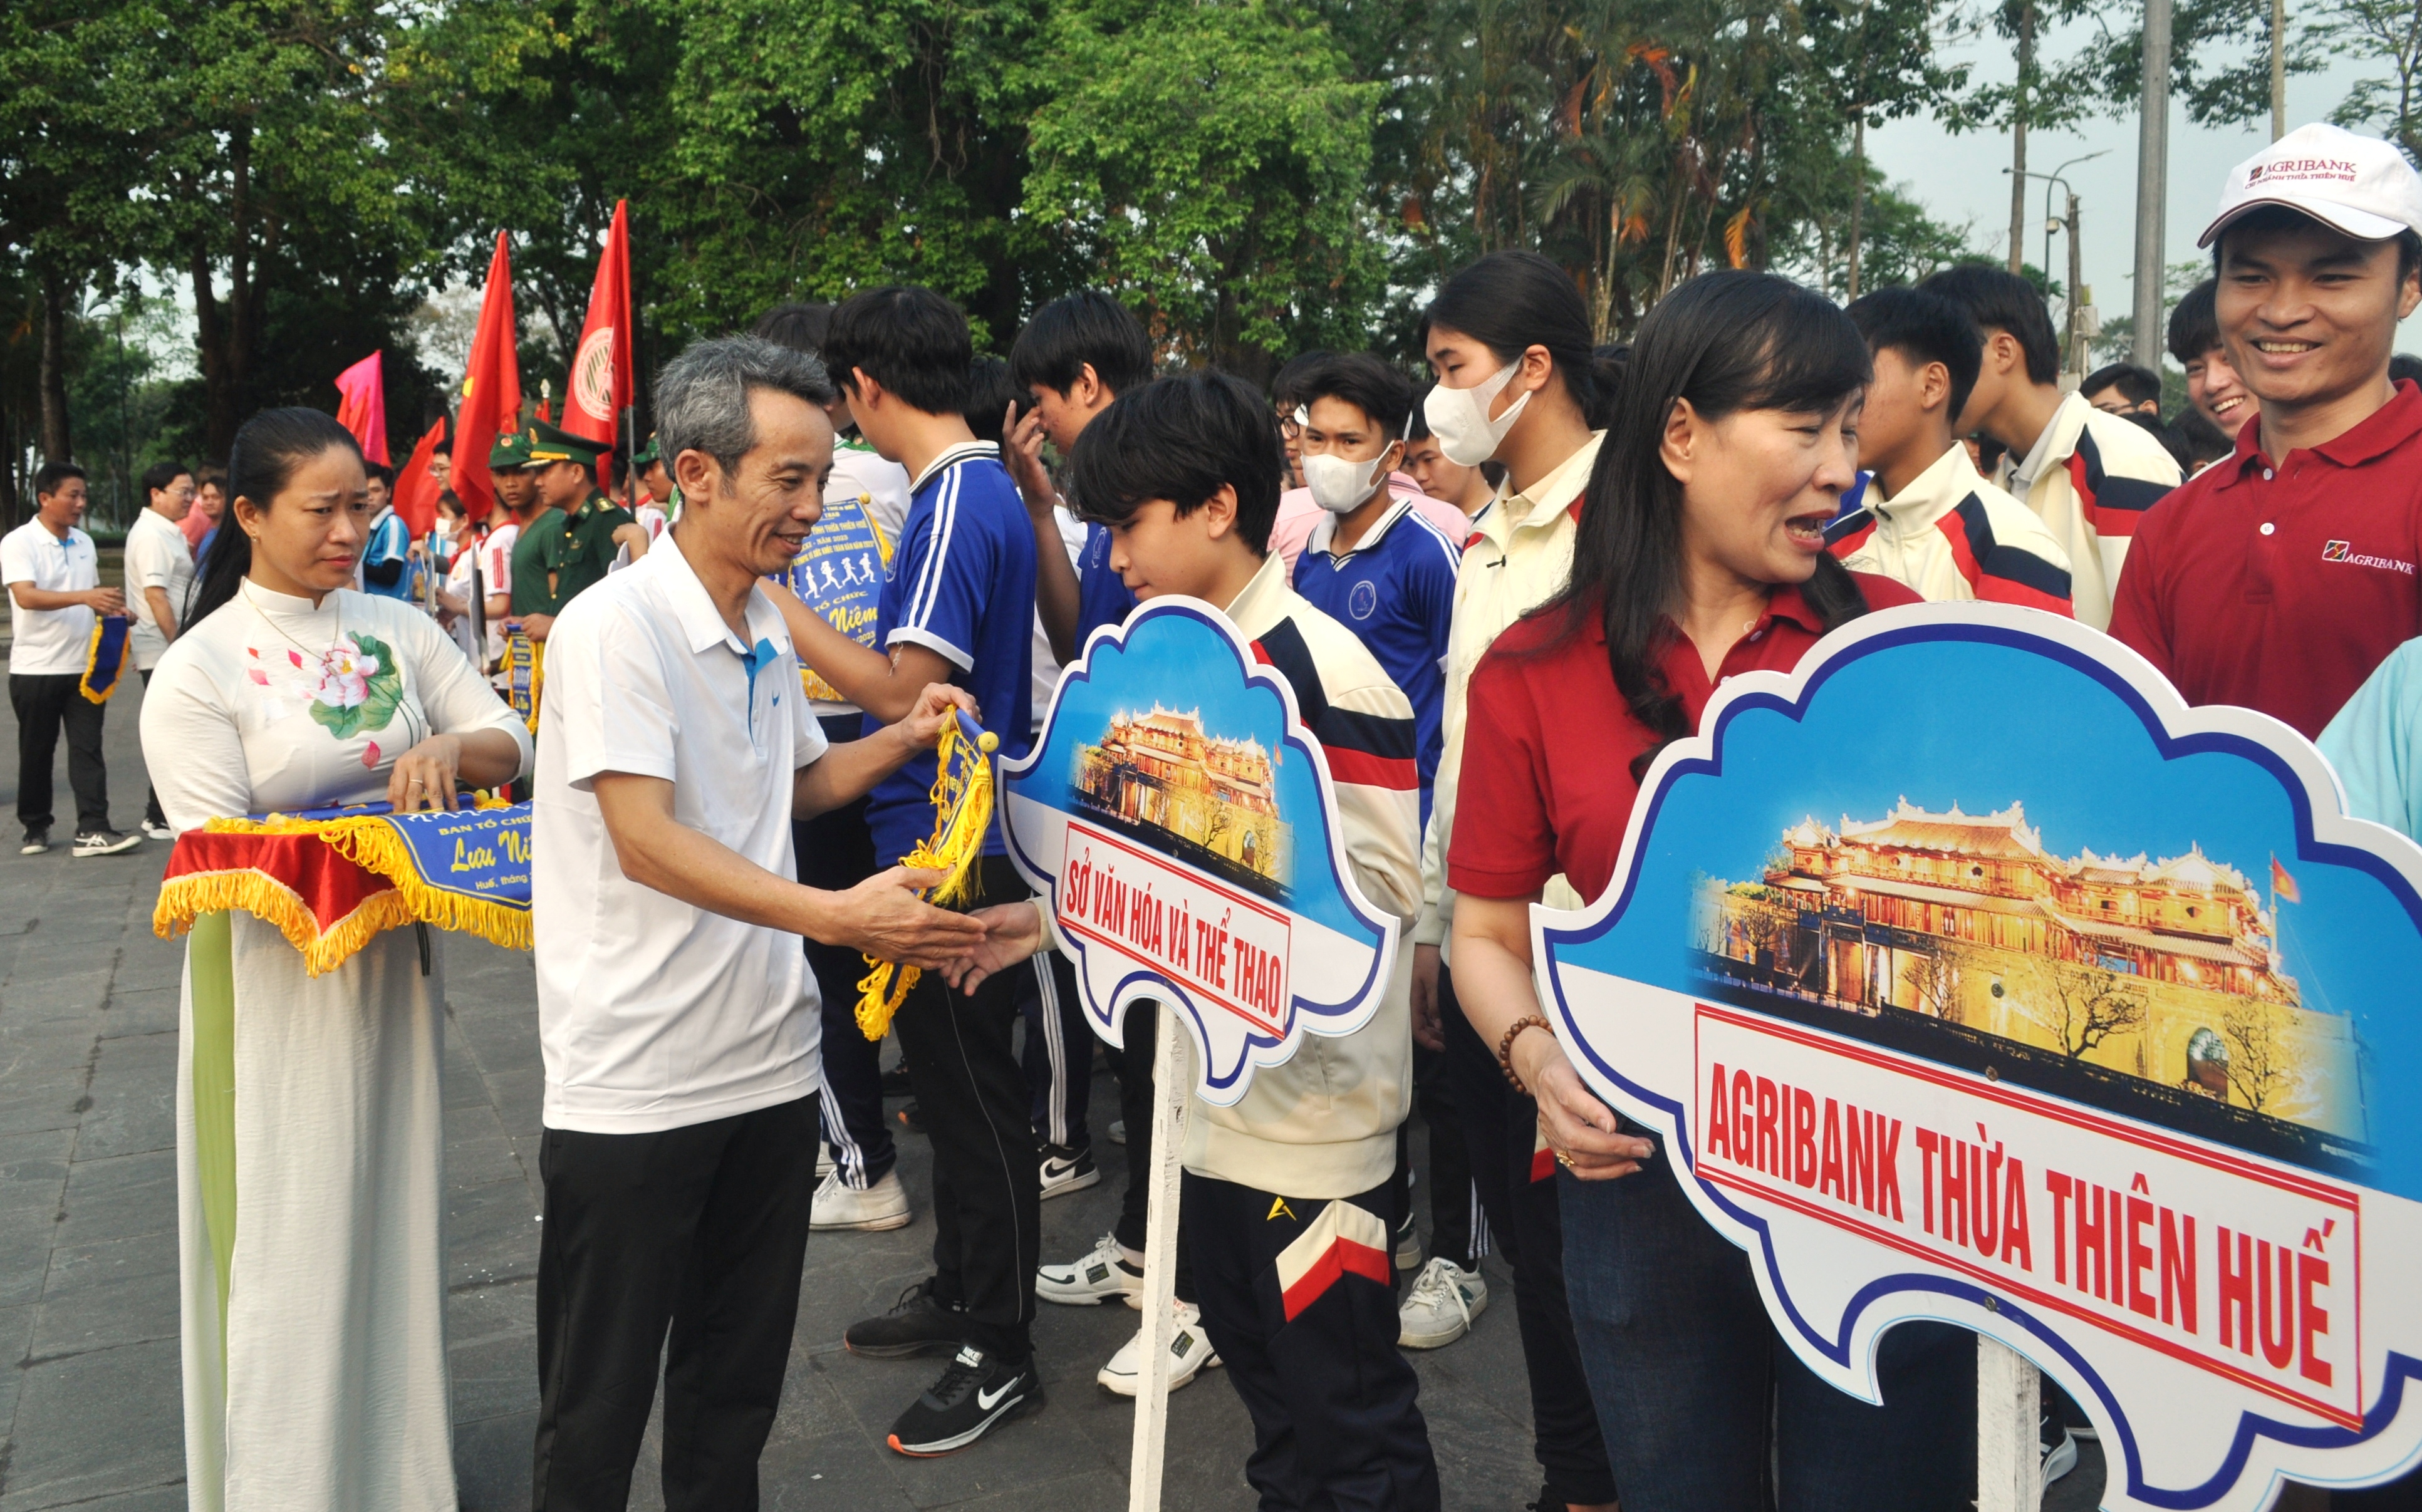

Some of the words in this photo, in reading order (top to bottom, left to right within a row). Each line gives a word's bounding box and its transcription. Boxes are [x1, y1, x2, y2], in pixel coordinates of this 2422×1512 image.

[2263, 159, 2357, 175] AGRIBANK
[2257, 174, 2285, 185] NHÁNH
[2338, 173, 2357, 182] HUẾ
[2344, 553, 2415, 574] AGRIBANK
[829, 605, 878, 633] Niệm
[438, 824, 472, 836] BAN
[474, 818, 498, 830] TỔ
[501, 814, 532, 826] CHỨ
[450, 837, 497, 873] Lưu
[501, 874, 528, 886] tháng
[1066, 846, 1091, 918] SỞ
[1094, 863, 1127, 938] VĂN
[1129, 882, 1162, 957] HÓA
[1169, 898, 1188, 971] VÀ
[1196, 907, 1231, 991] THỂ
[1234, 936, 1281, 1018] THAO
[1708, 1063, 1904, 1223] AGRIBANK
[1916, 1122, 2033, 1273] THỪA
[2046, 1169, 2197, 1335] THIÊN
[2217, 1217, 2336, 1388] HUẾ
[962, 1346, 982, 1362] NIKE
